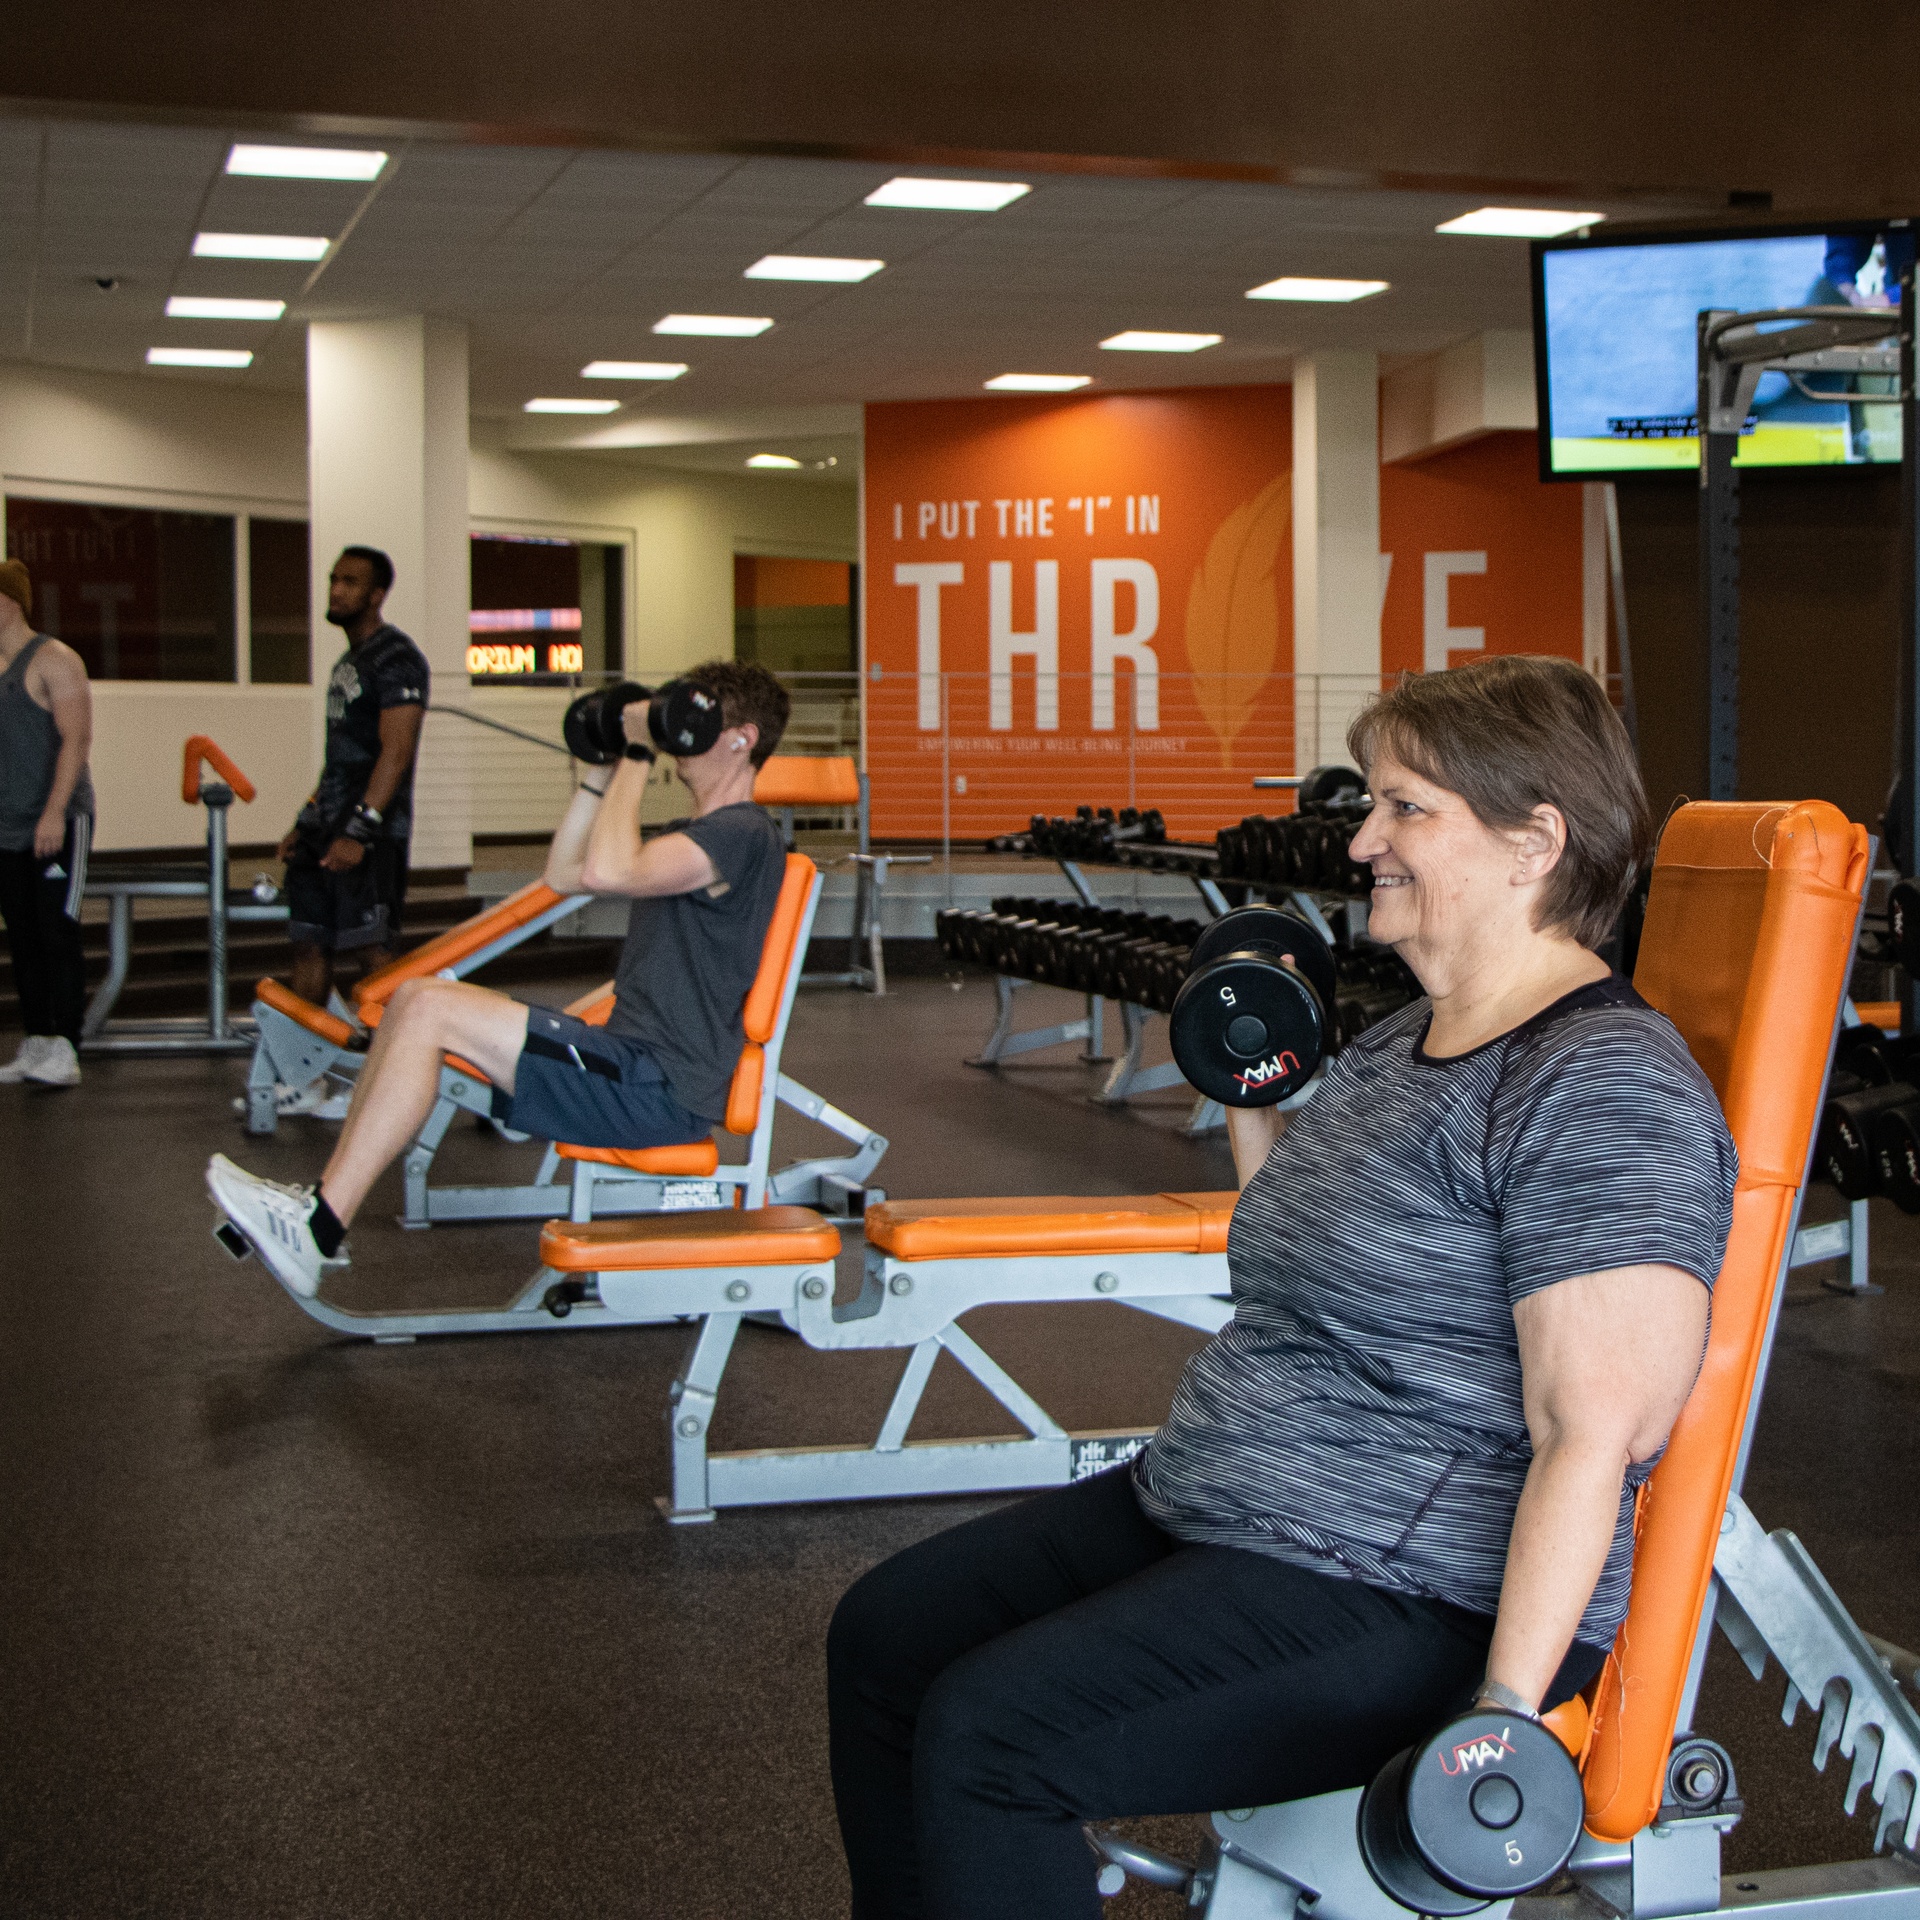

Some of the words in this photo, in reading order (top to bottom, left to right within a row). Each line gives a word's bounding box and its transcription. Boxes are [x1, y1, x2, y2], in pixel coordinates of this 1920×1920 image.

[894, 502, 903, 540] I
[918, 500, 980, 540] PUT
[994, 498, 1054, 538] THE
[1126, 494, 1160, 535] IN
[917, 737, 1002, 751] EMPWERING
[1219, 986, 1237, 1007] 5
[1232, 1050, 1301, 1096] UMAX
[1438, 1726, 1516, 1776] UMAX
[1504, 1839, 1523, 1865] 5
